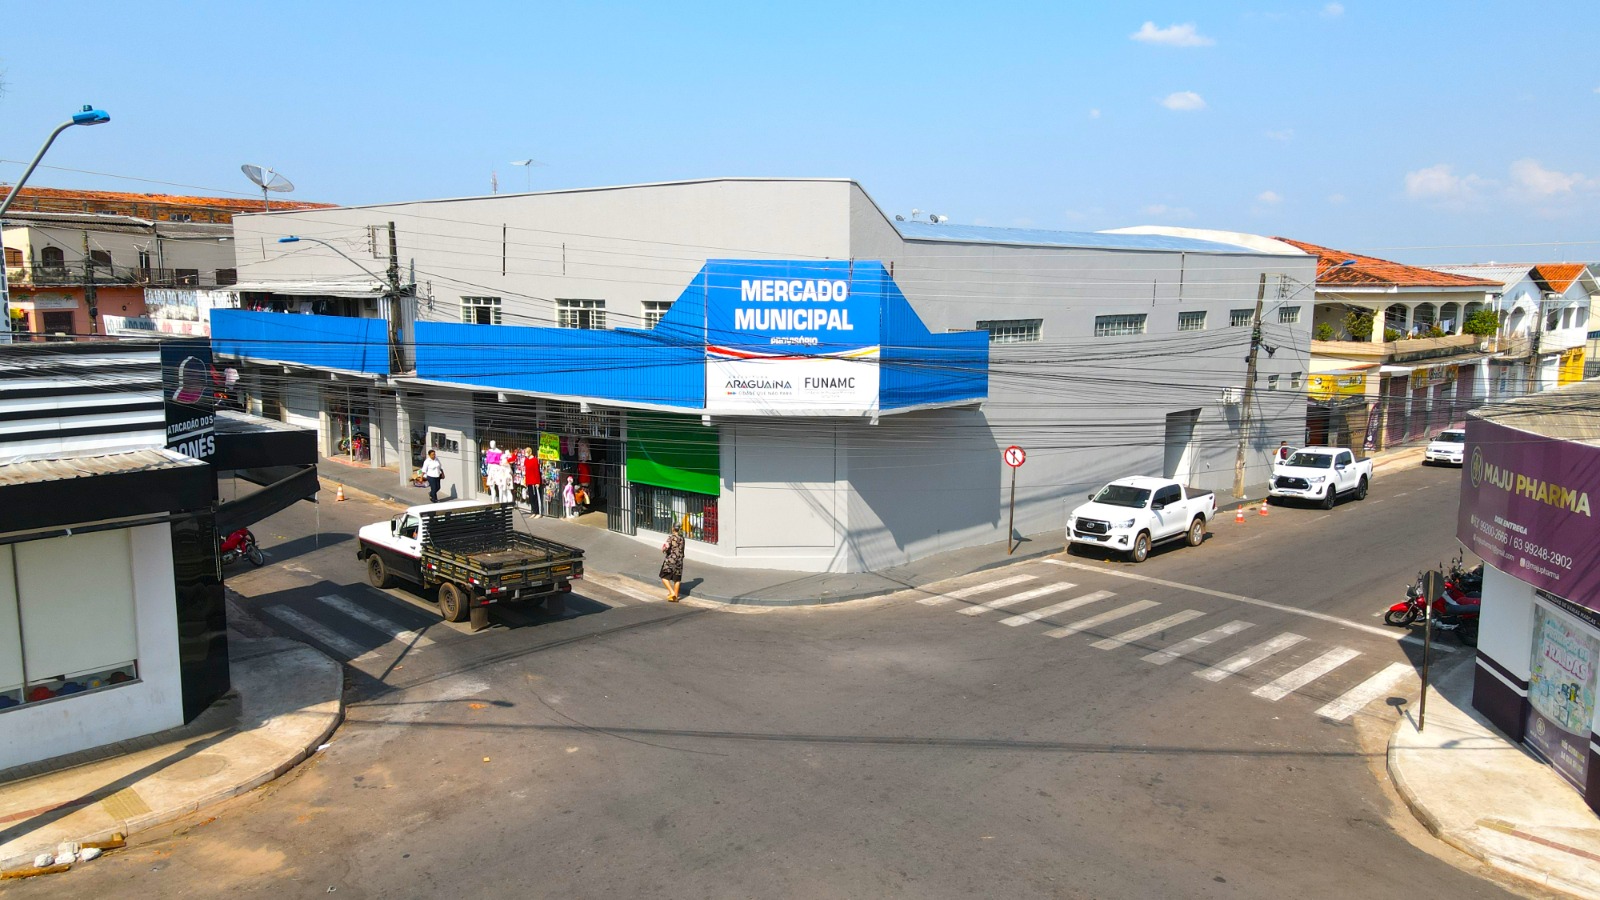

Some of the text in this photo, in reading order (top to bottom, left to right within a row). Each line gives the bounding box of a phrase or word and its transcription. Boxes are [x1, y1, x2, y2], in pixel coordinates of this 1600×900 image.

[741, 279, 847, 302] MERCADO
[735, 308, 854, 331] MUNICIPAL
[804, 377, 855, 389] FUNAMC
[167, 415, 213, 436] ATACADÃO DOS
[1484, 462, 1591, 517] MAJU PHARMA
[1503, 520, 1528, 535] ENTREGA
[1514, 537, 1523, 550] 63
[1524, 542, 1573, 570] 99248-2902
[1544, 639, 1587, 680] FRALDAS
